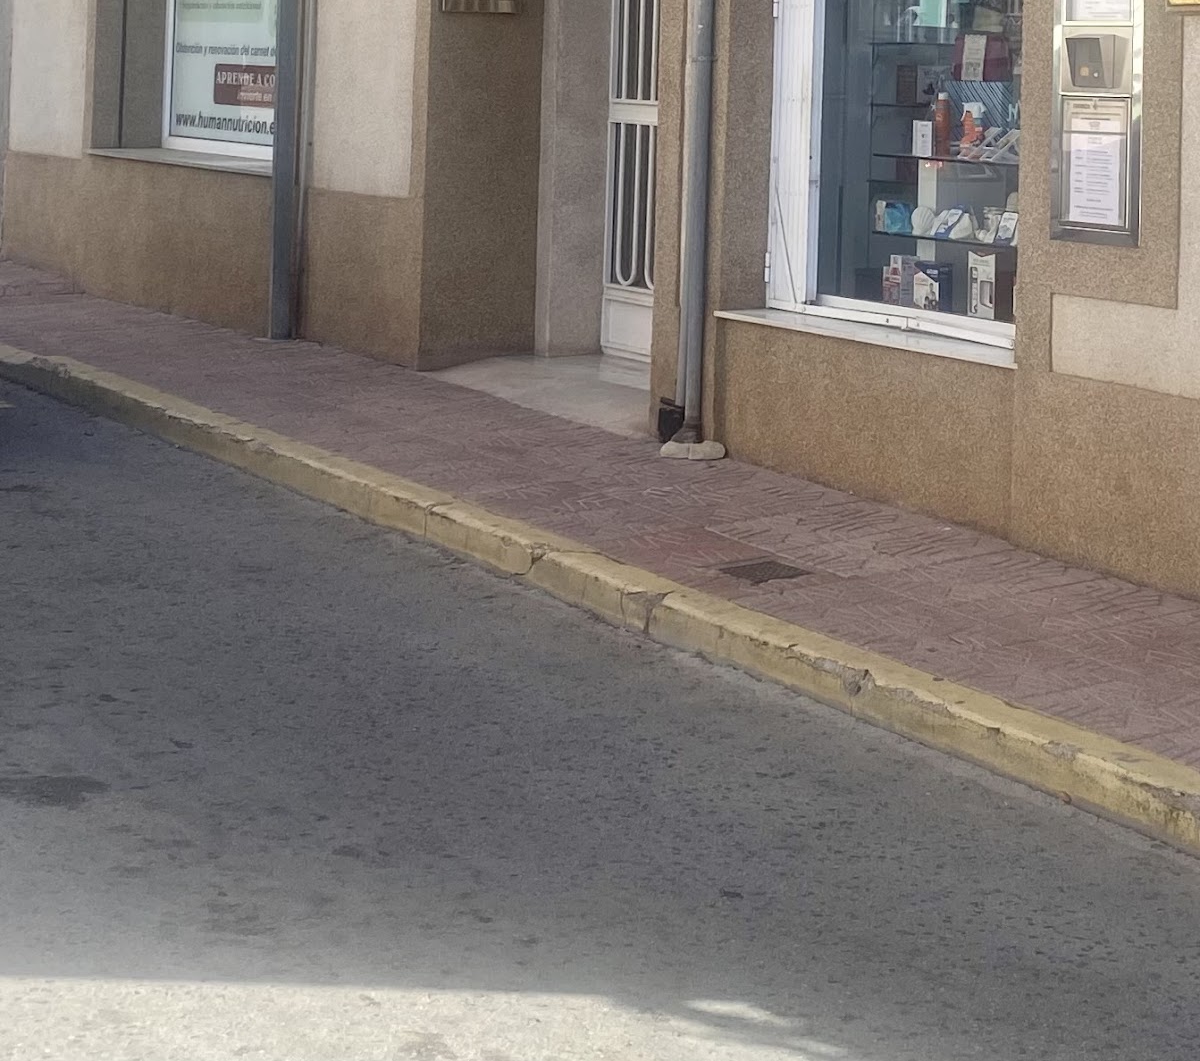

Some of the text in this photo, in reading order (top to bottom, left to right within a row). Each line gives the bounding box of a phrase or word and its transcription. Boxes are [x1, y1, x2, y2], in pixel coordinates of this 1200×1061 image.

[216, 71, 254, 86] APRENDE
[263, 73, 275, 88] CO
[175, 110, 275, 135] www.humannutricion.e
